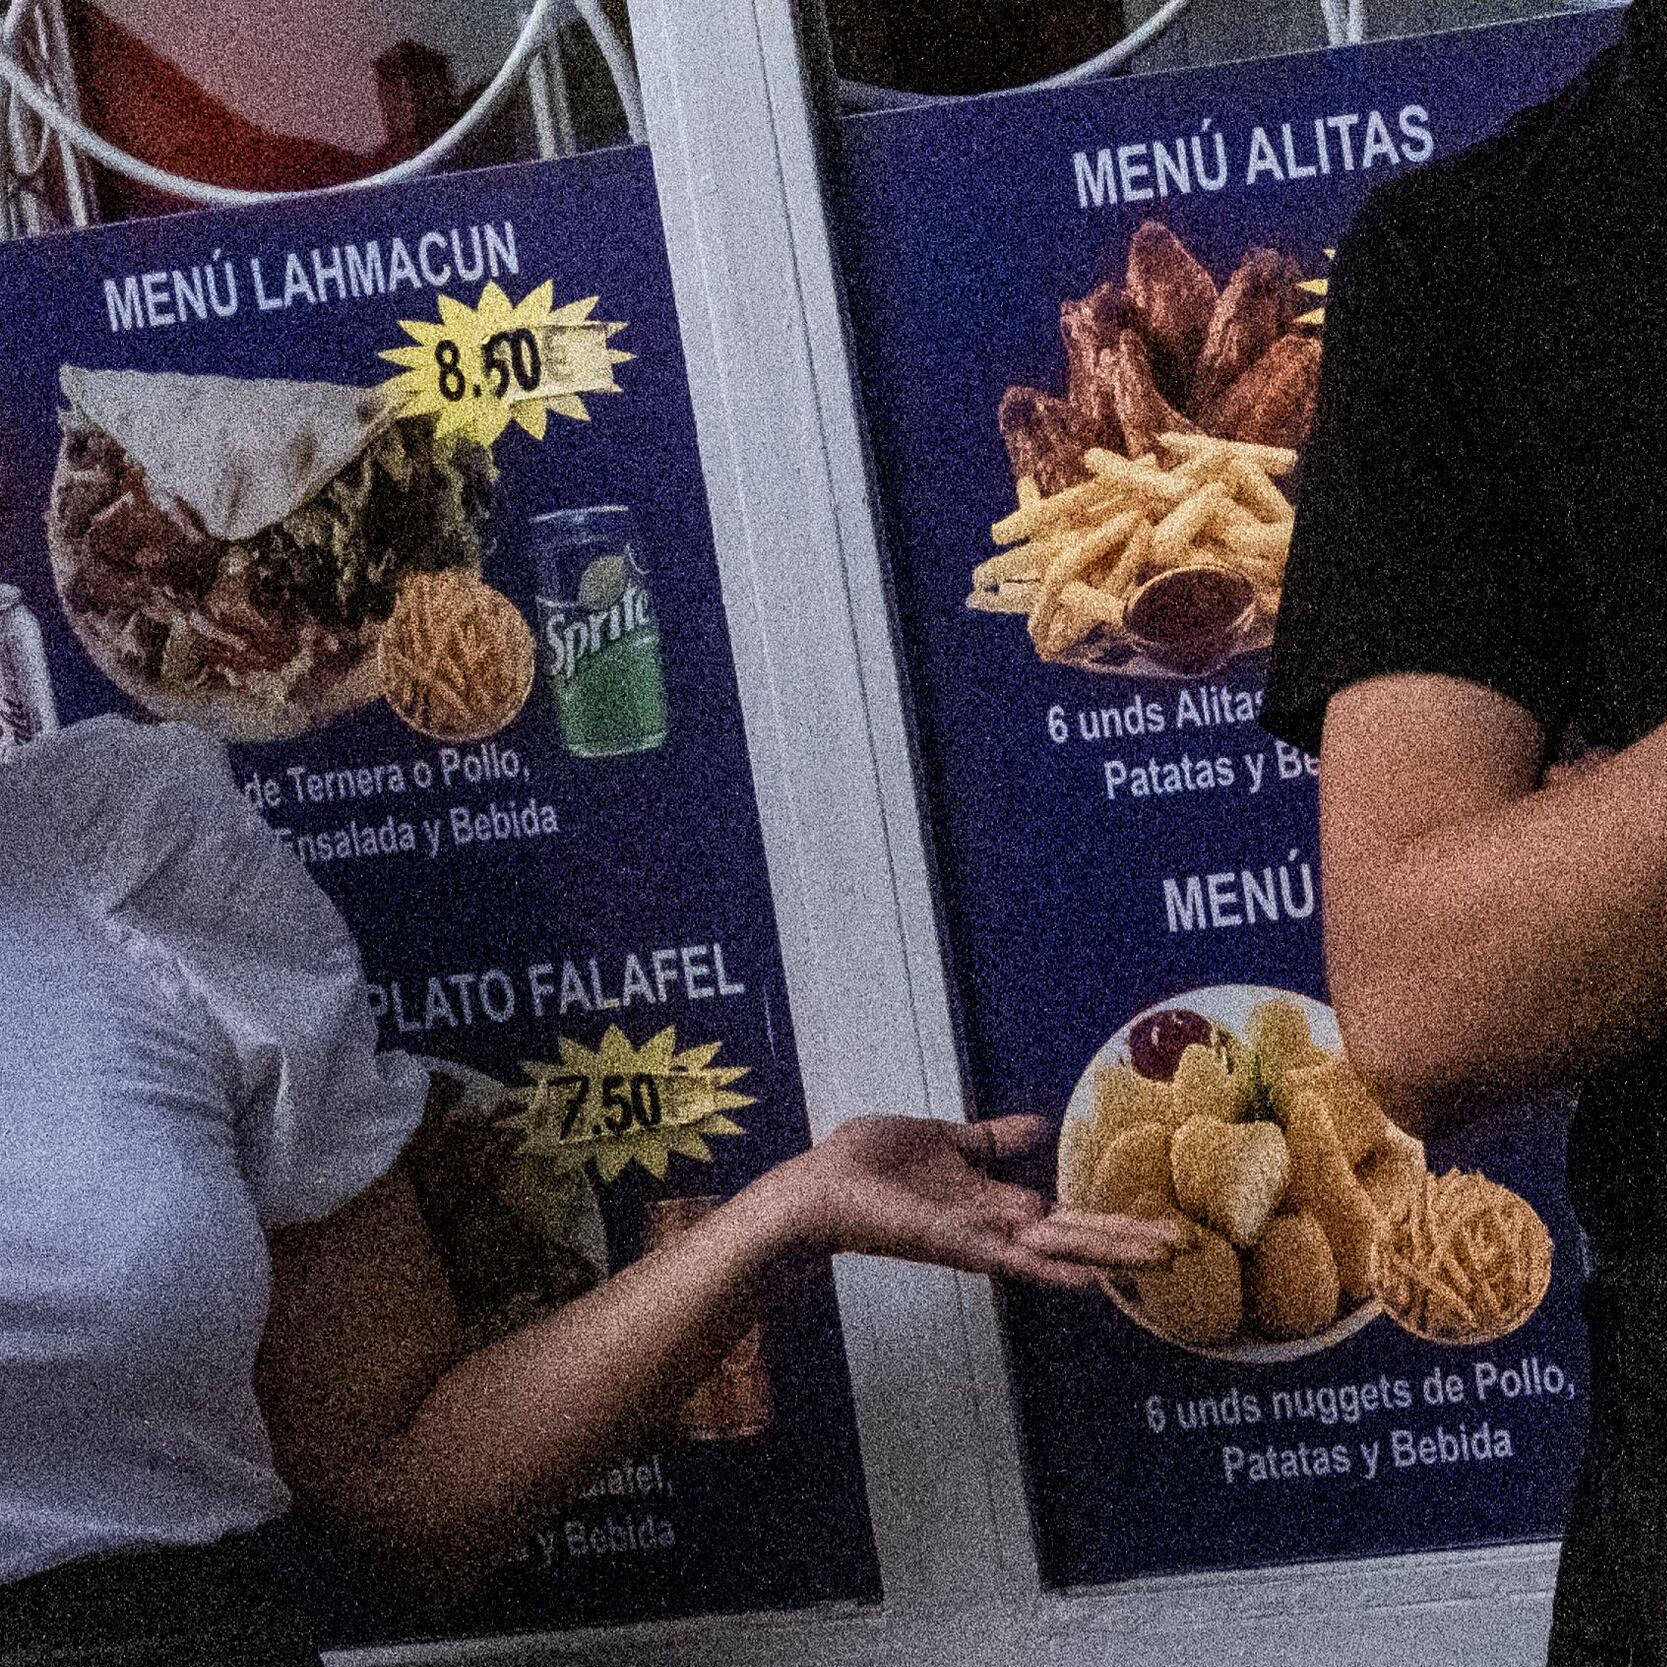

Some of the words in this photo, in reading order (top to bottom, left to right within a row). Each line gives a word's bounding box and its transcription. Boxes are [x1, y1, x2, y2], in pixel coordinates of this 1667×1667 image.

[1072, 117, 1228, 209] MENÚ
[1246, 103, 1434, 185] ALITAS
[102, 249, 238, 332] MENÚ
[249, 221, 519, 312] LAHMACUN
[546, 578, 650, 679] Sprite
[1047, 703, 1068, 744] 6
[1078, 694, 1165, 742] unds
[286, 762, 407, 803] Ternera
[413, 765, 434, 790] o
[442, 743, 531, 785] Pollo,
[1104, 752, 1235, 800] Patatas
[1243, 753, 1265, 794] y
[422, 815, 443, 857] y
[450, 798, 560, 845] Bebida
[1162, 849, 1315, 933] MENÚ
[528, 942, 746, 1018] FALAFEL
[549, 1074, 662, 1140] 7.50
[1146, 1396, 1166, 1433] 6
[1176, 1388, 1263, 1431] unds
[1271, 1374, 1413, 1426] nuggets
[1422, 1366, 1465, 1406] de
[1474, 1356, 1576, 1401] Pollo,
[1222, 1440, 1351, 1484] Patatas
[1360, 1441, 1380, 1480] y
[1390, 1421, 1514, 1478] Bebida
[563, 1513, 677, 1558] Bebida
